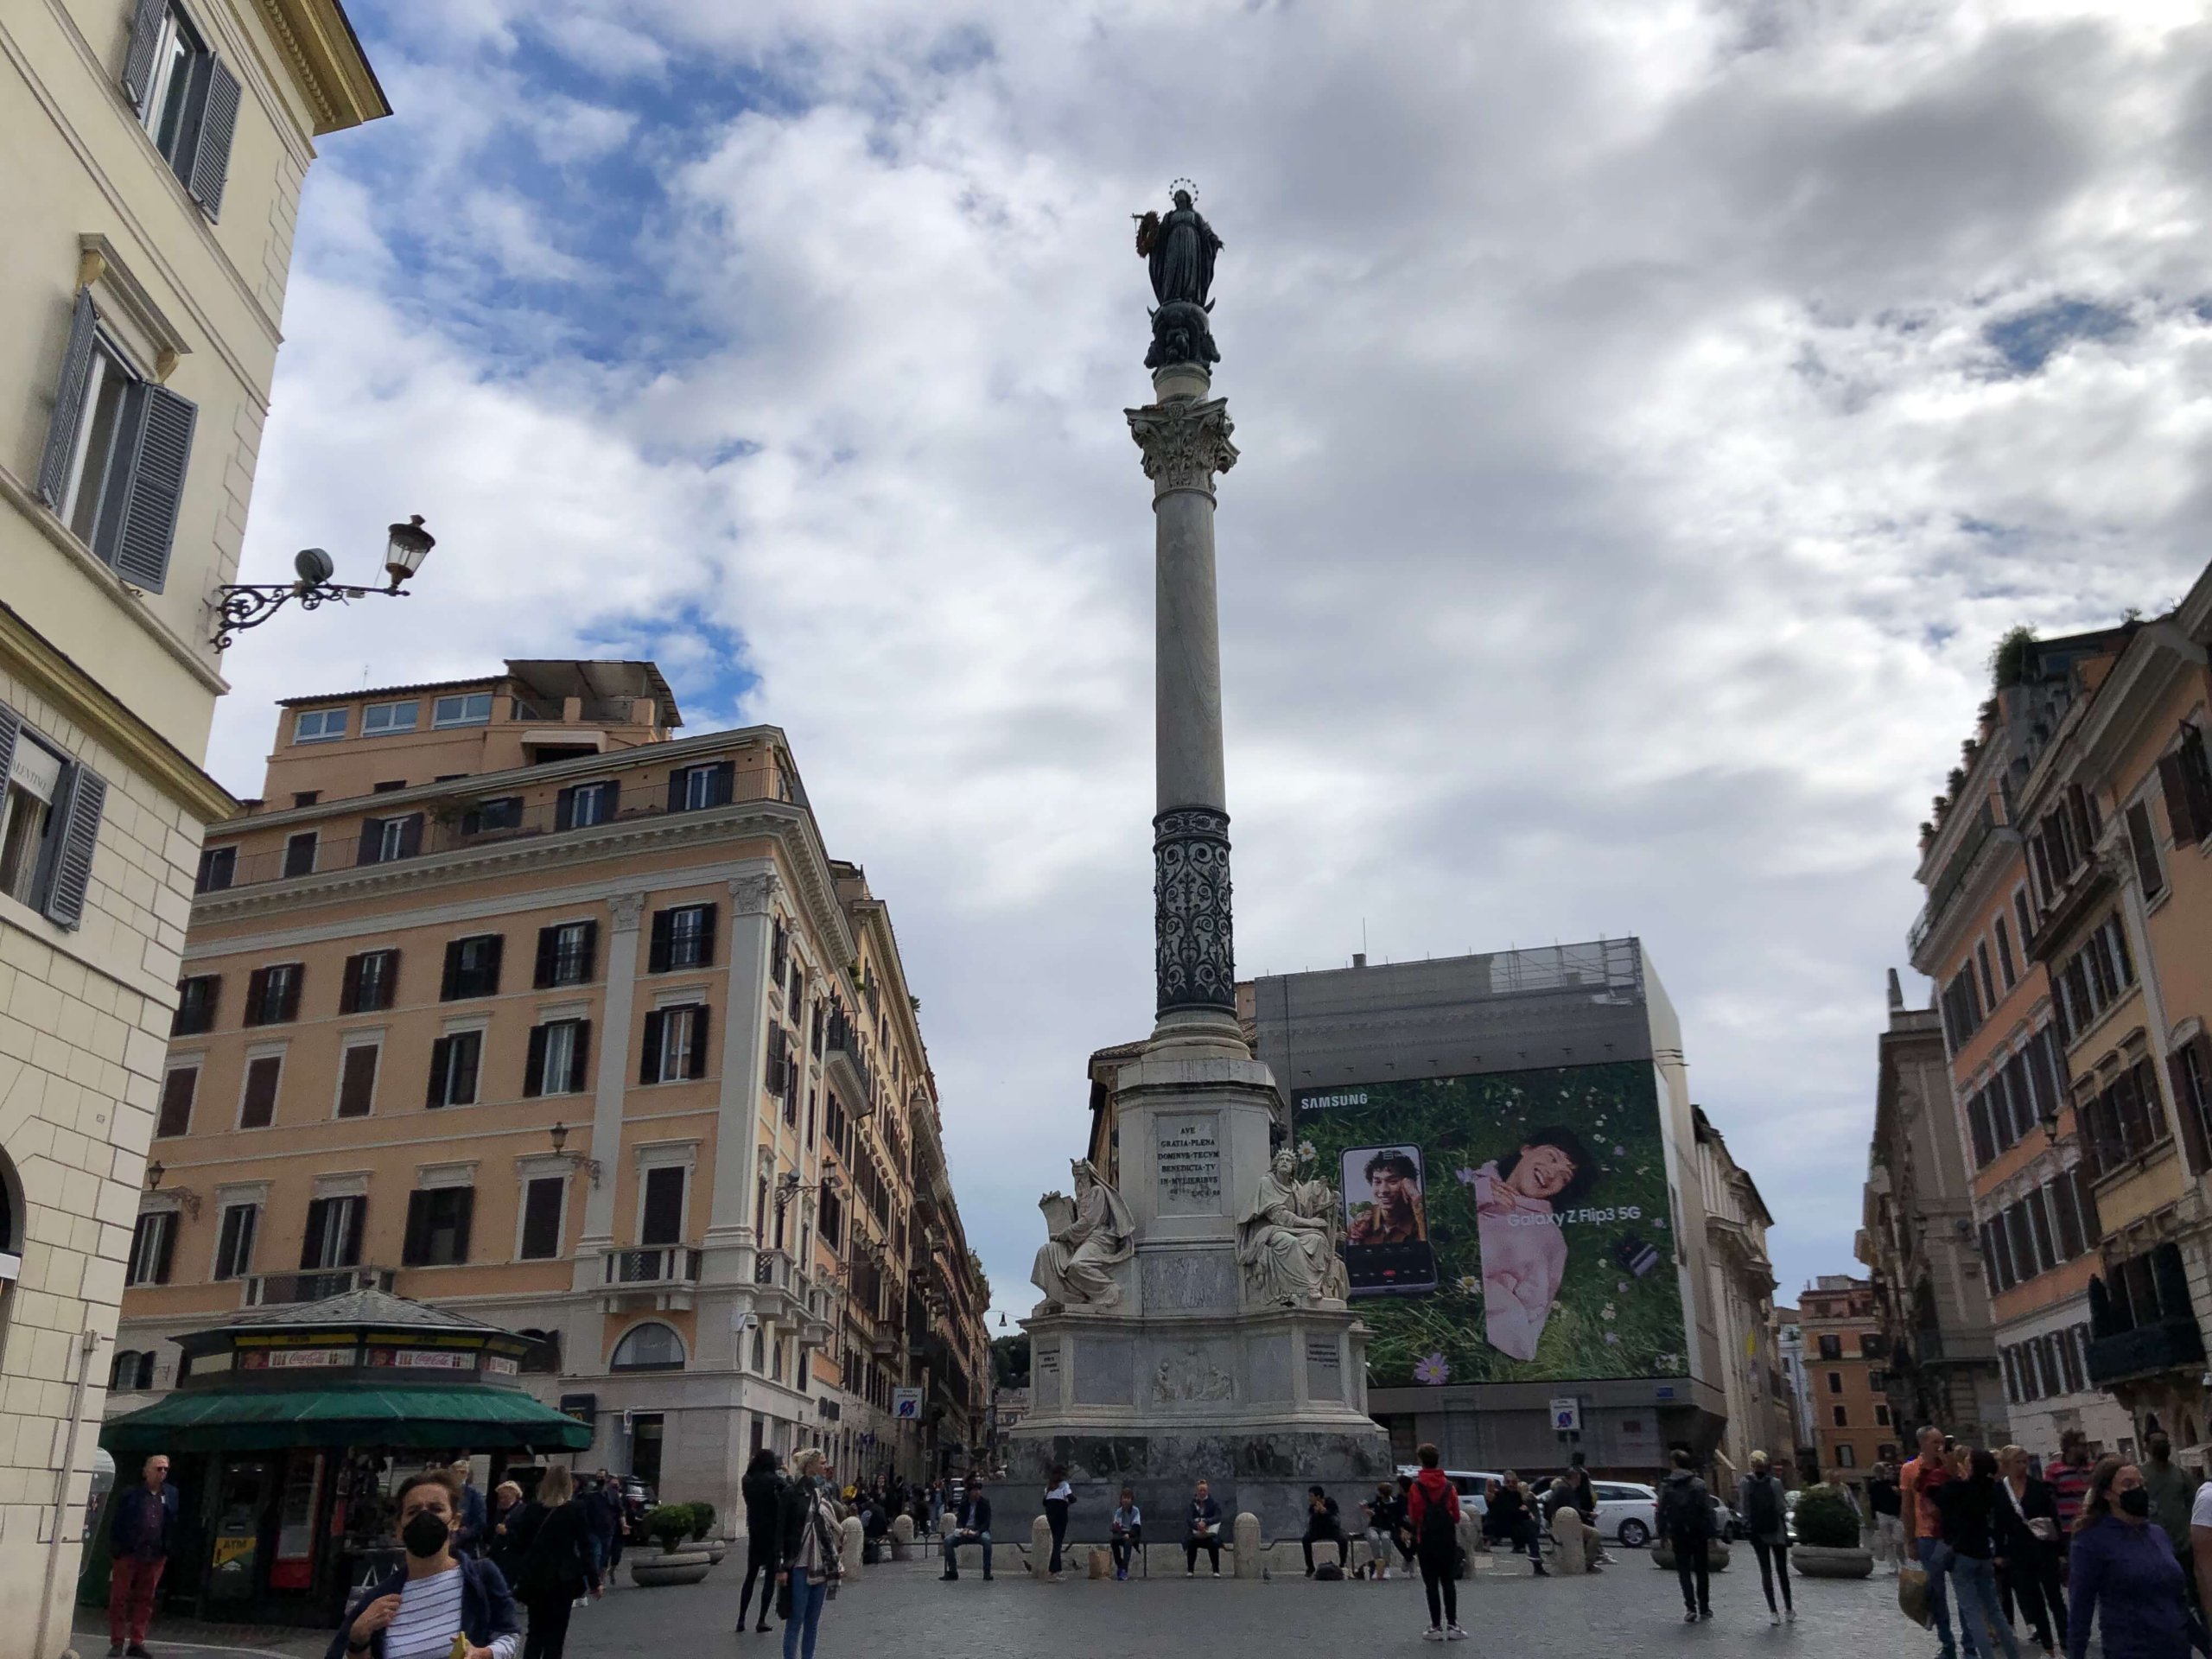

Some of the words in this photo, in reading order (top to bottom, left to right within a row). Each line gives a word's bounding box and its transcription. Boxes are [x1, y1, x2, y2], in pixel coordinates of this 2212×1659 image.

[1301, 1093, 1368, 1109] SAMSUNG
[1507, 1211, 1565, 1227] Galaxy
[1567, 1211, 1577, 1223] Z
[1580, 1207, 1615, 1225] Flip3
[1618, 1206, 1641, 1220] 5G
